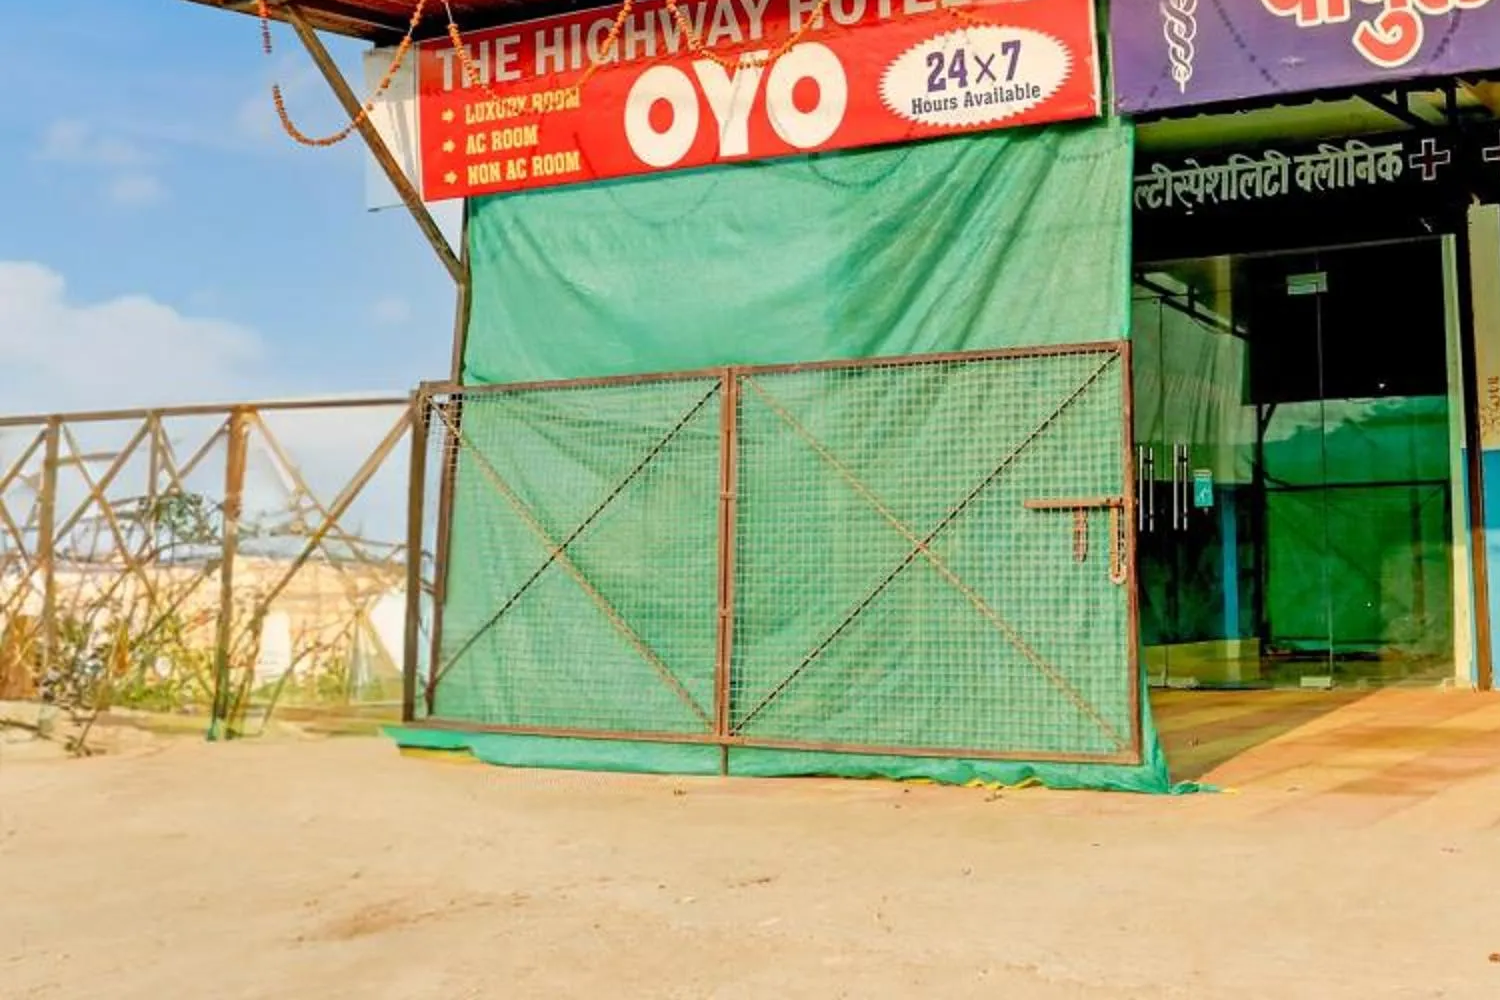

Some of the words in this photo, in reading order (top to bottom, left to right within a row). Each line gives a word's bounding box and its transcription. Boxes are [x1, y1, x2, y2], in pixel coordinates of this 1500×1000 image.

[435, 33, 522, 91] THE
[623, 41, 848, 168] OYO
[911, 95, 958, 115] Hours
[963, 83, 1041, 108] Available
[465, 132, 487, 155] AC
[491, 124, 539, 151] ROOM
[467, 161, 501, 187] NON
[505, 157, 527, 181] AC
[532, 149, 581, 177] ROOM
[1134, 149, 1293, 210] ल्टीस्पेशलिटी
